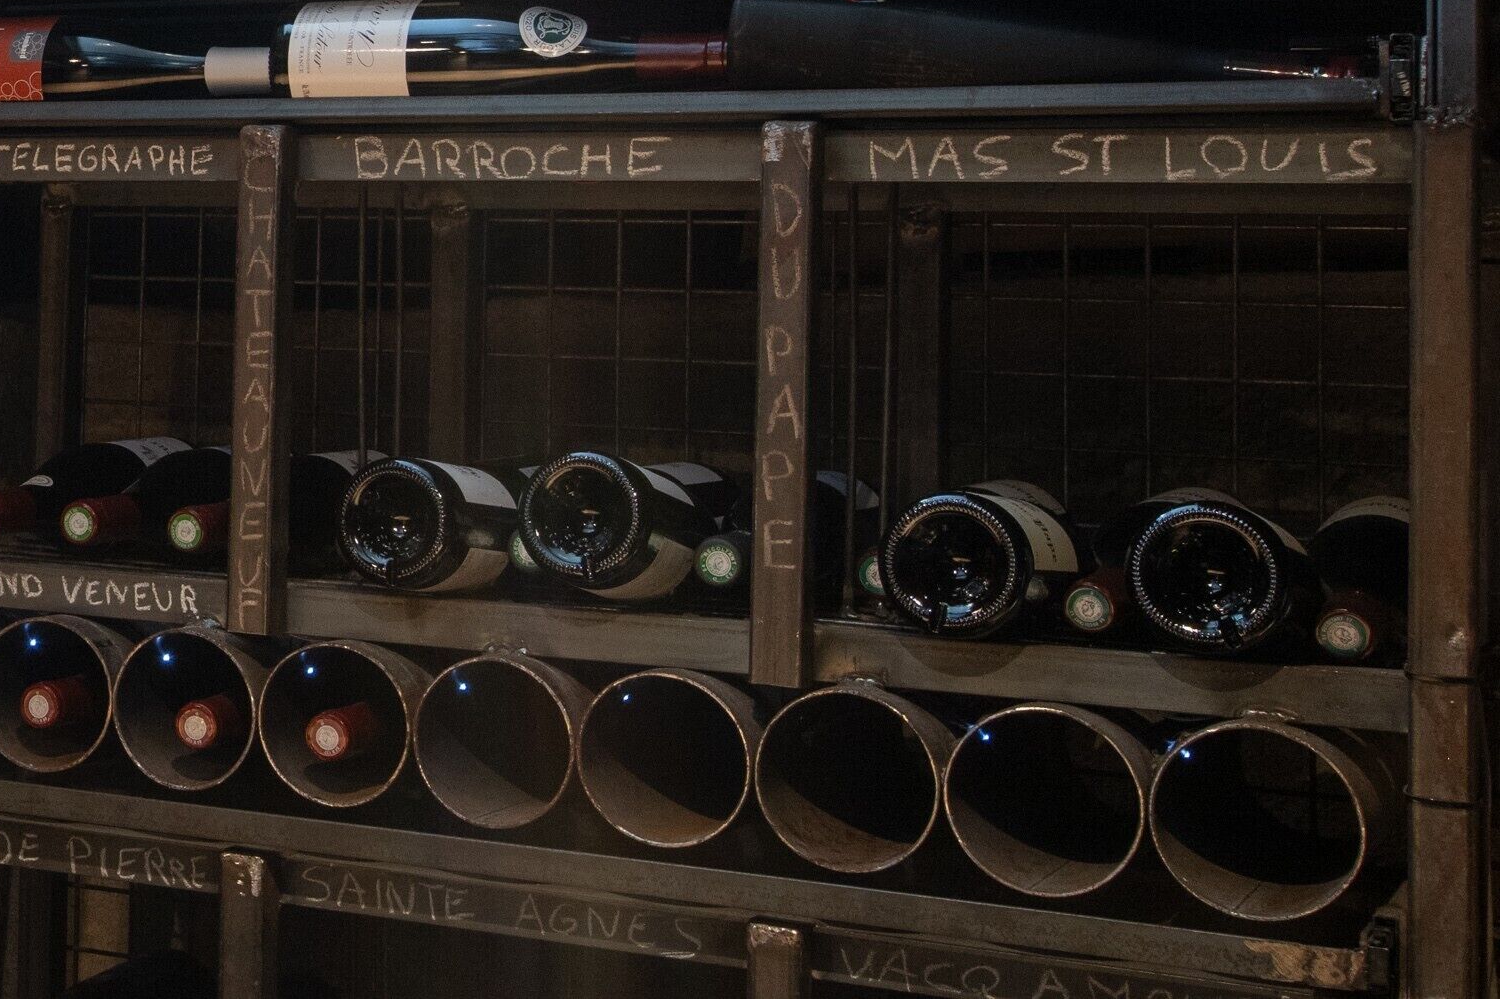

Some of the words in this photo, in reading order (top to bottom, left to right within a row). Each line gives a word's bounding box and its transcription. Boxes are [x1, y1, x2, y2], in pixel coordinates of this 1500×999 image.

[354, 135, 672, 180] BARROCHE
[869, 134, 1012, 181] MAS
[1051, 132, 1129, 177] ST
[1165, 133, 1379, 183] LOUIS
[771, 182, 803, 301] DU
[236, 155, 274, 631] CHATEAUNEUF
[761, 325, 800, 570] PAPE
[61, 575, 200, 618] VENEUR
[66, 835, 209, 889] PIERRE
[300, 864, 476, 922] SAINTE
[514, 892, 701, 959] AGNES
